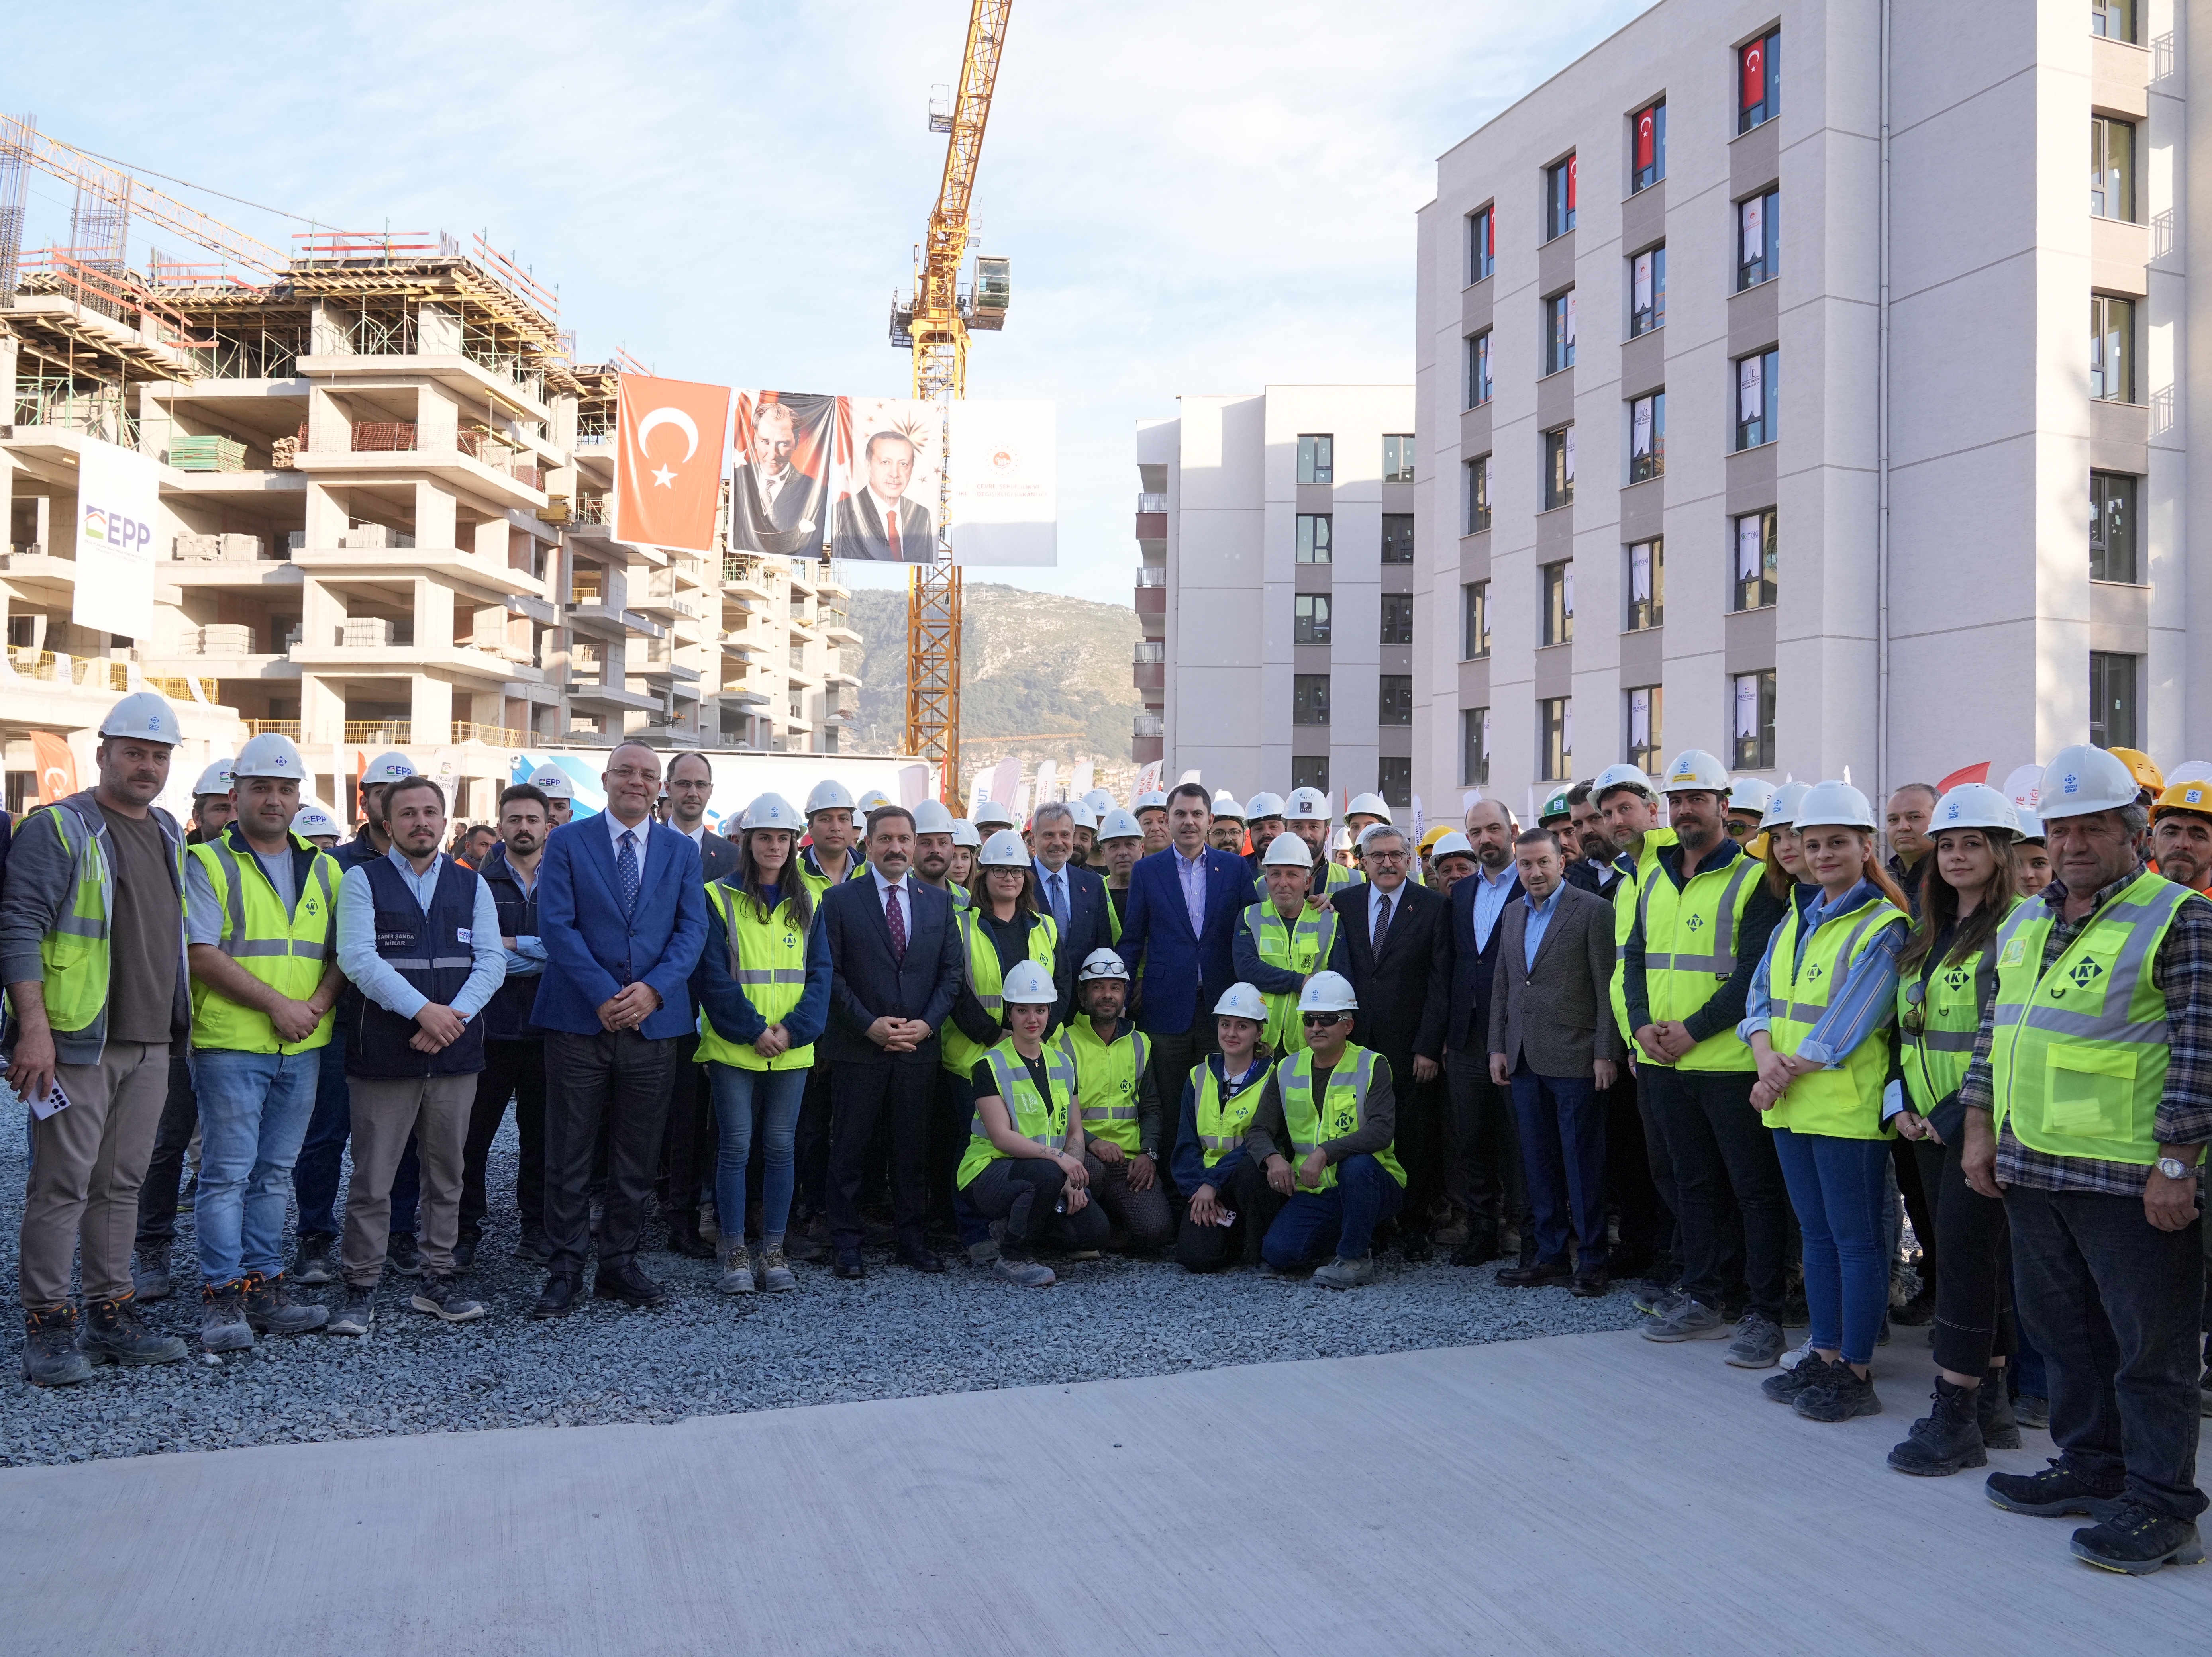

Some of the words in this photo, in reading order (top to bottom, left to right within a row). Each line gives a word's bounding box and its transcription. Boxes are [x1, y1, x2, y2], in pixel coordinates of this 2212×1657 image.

[108, 512, 151, 552] EPP
[396, 766, 412, 776] EPP
[435, 781, 453, 790] ÖNETİM
[1139, 778, 1145, 786] VE
[977, 787, 988, 809] NUT
[2077, 966, 2094, 978] K
[1950, 973, 1961, 983] K
[1061, 1111, 1066, 1120] K
[1341, 1117, 1348, 1126] K
